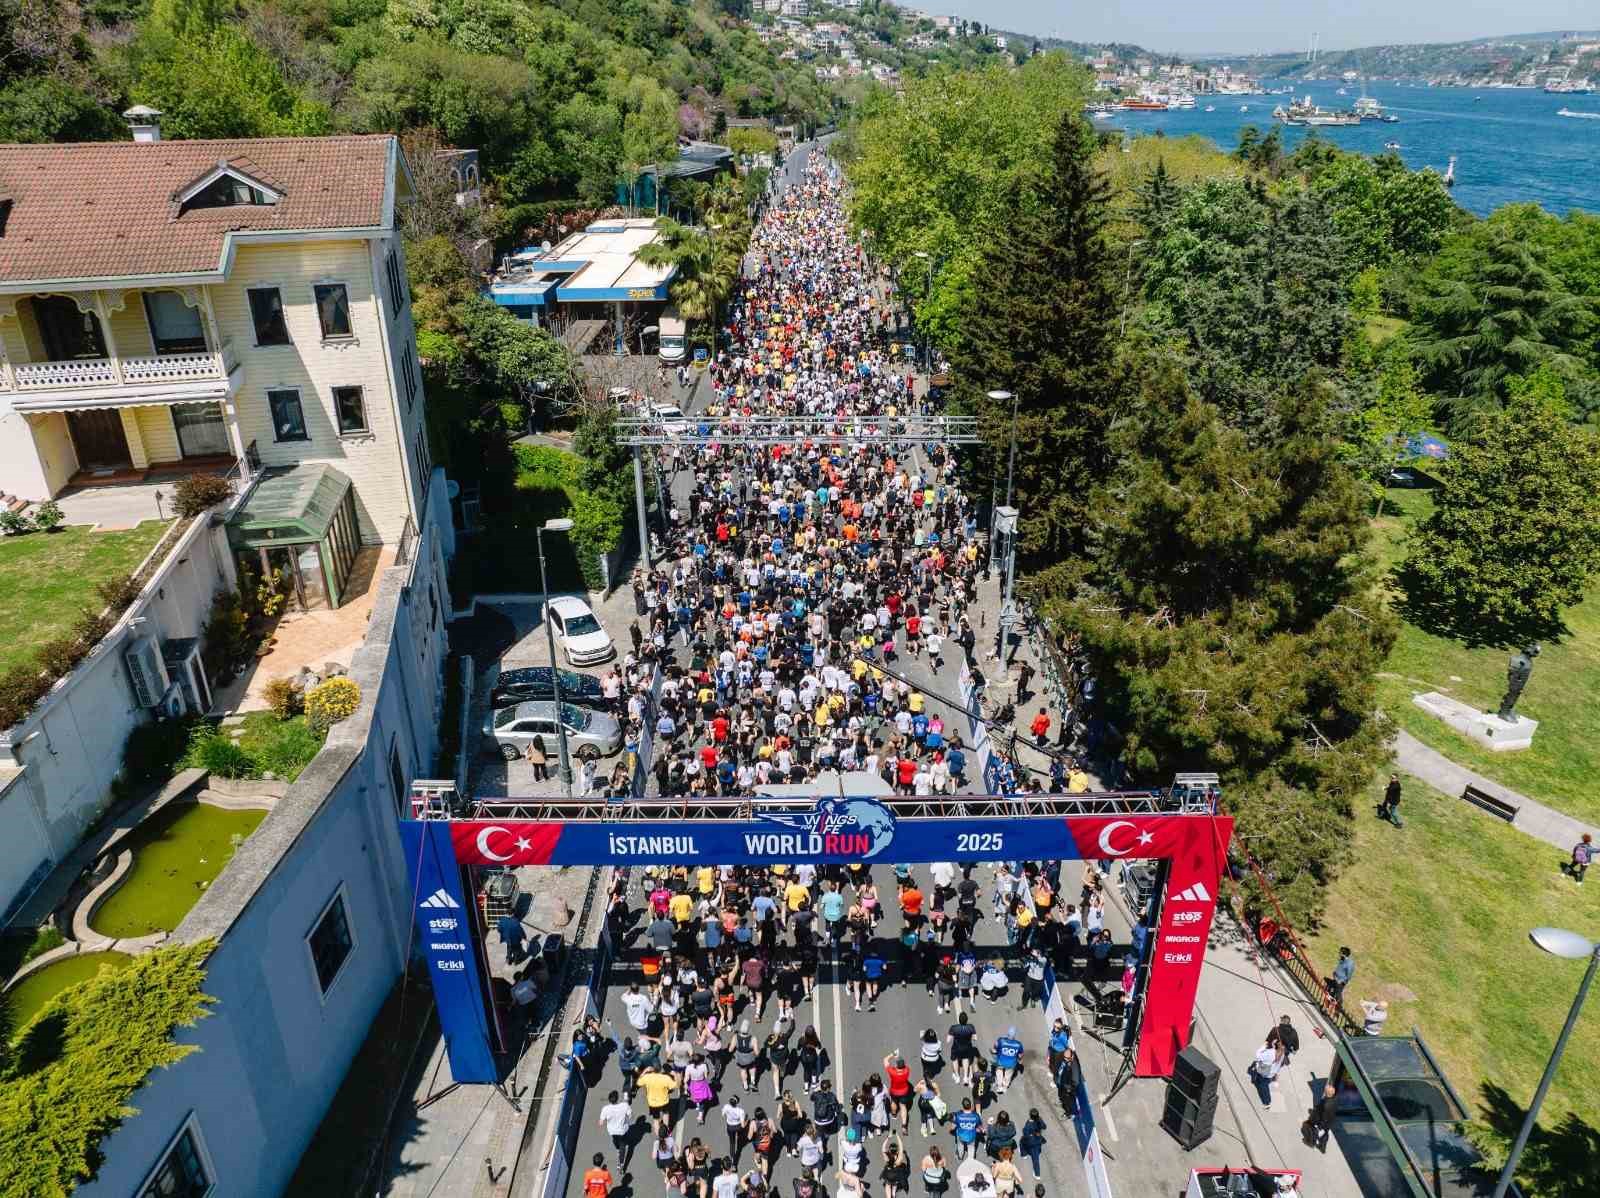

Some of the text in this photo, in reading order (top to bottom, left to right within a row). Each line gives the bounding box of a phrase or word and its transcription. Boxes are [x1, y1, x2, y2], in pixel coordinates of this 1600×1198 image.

[609, 832, 699, 855] İSTANBUL
[744, 833, 869, 855] WORLD RUN
[956, 833, 1003, 851] 2025
[1165, 935, 1200, 943] MIGROS
